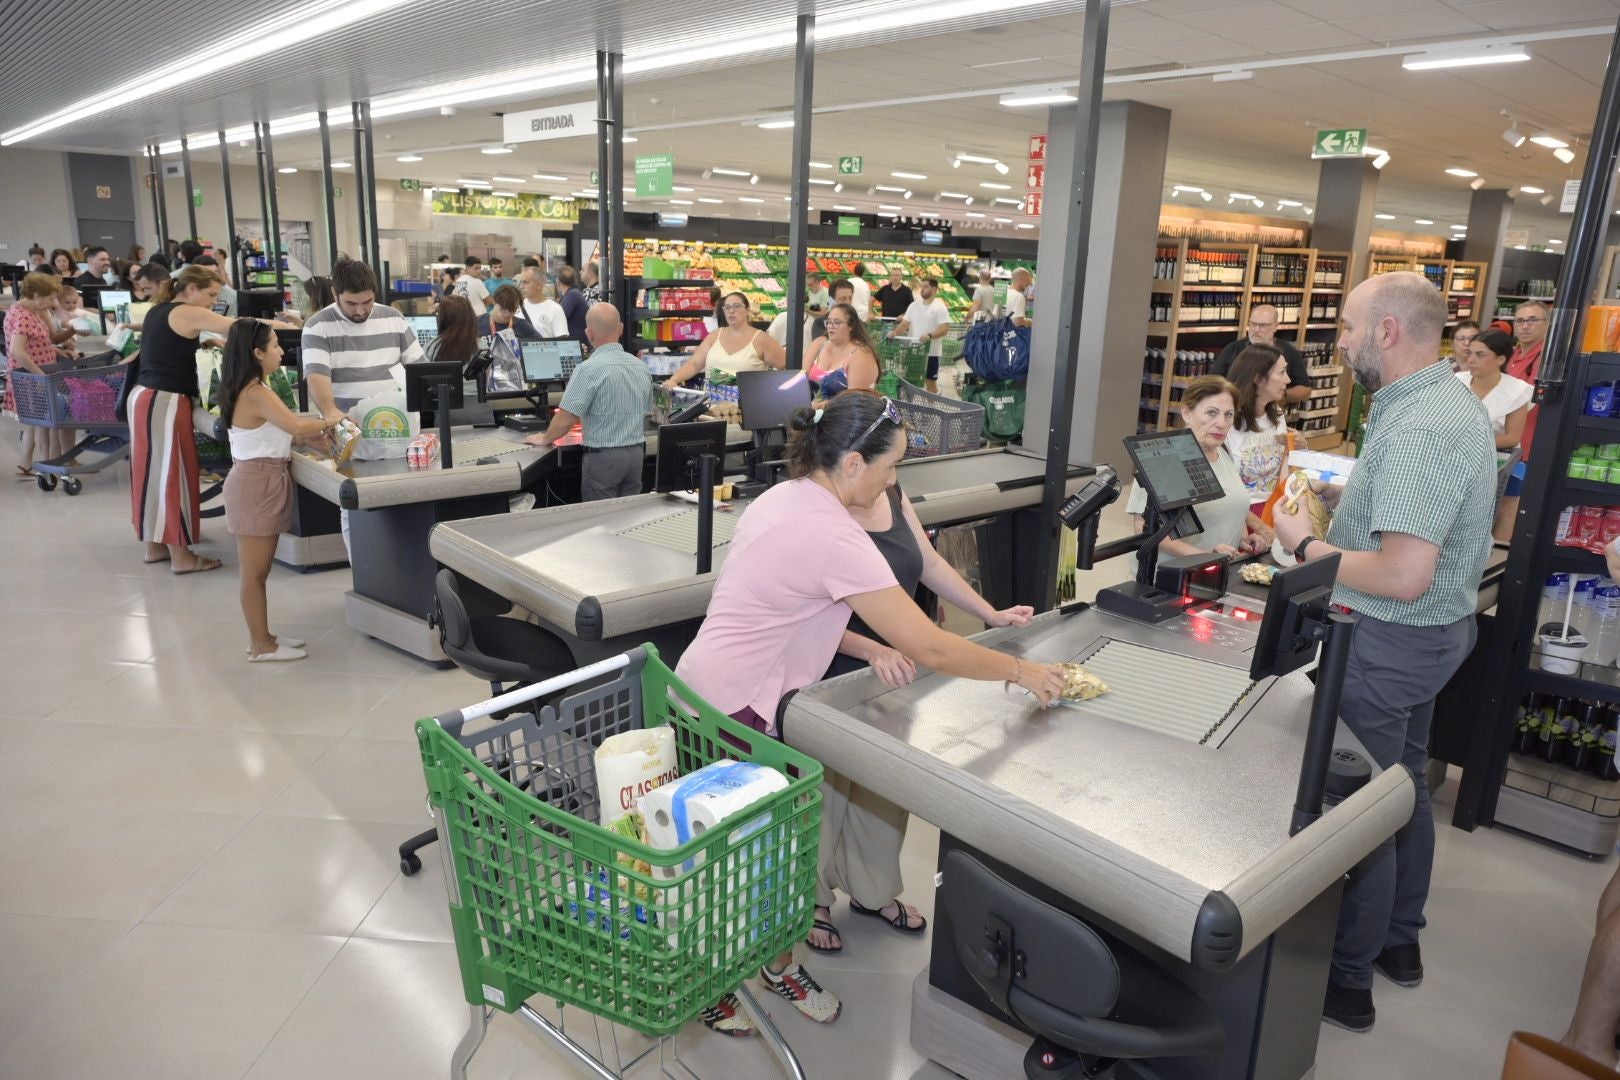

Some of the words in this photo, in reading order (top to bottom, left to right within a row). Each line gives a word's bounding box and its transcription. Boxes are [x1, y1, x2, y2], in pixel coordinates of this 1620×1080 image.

[531, 114, 574, 132] ENTRADA
[451, 195, 492, 209] LISTO
[496, 198, 535, 212] PARA
